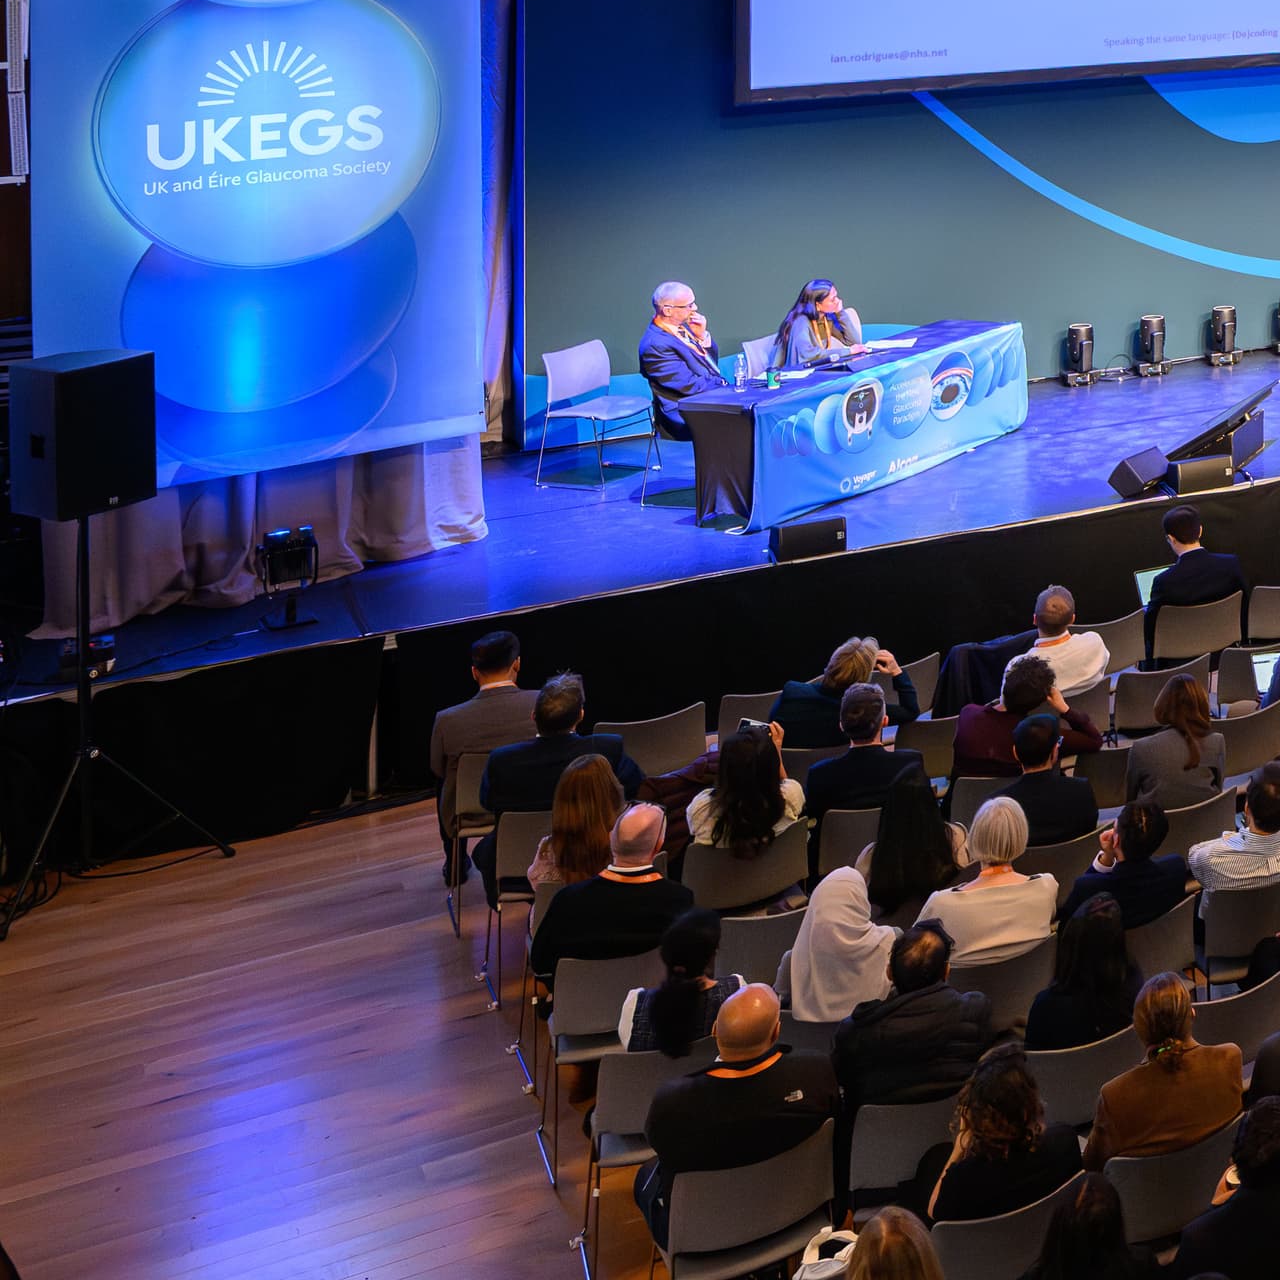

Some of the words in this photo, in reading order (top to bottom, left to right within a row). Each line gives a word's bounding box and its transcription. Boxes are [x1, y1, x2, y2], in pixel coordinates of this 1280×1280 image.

[1104, 37, 1144, 49] Speaking
[146, 105, 383, 170] UKEGS
[143, 181, 168, 196] UK
[173, 176, 202, 192] and
[208, 172, 241, 188] Éire
[246, 166, 327, 184] Glaucoma
[332, 161, 391, 177] Society
